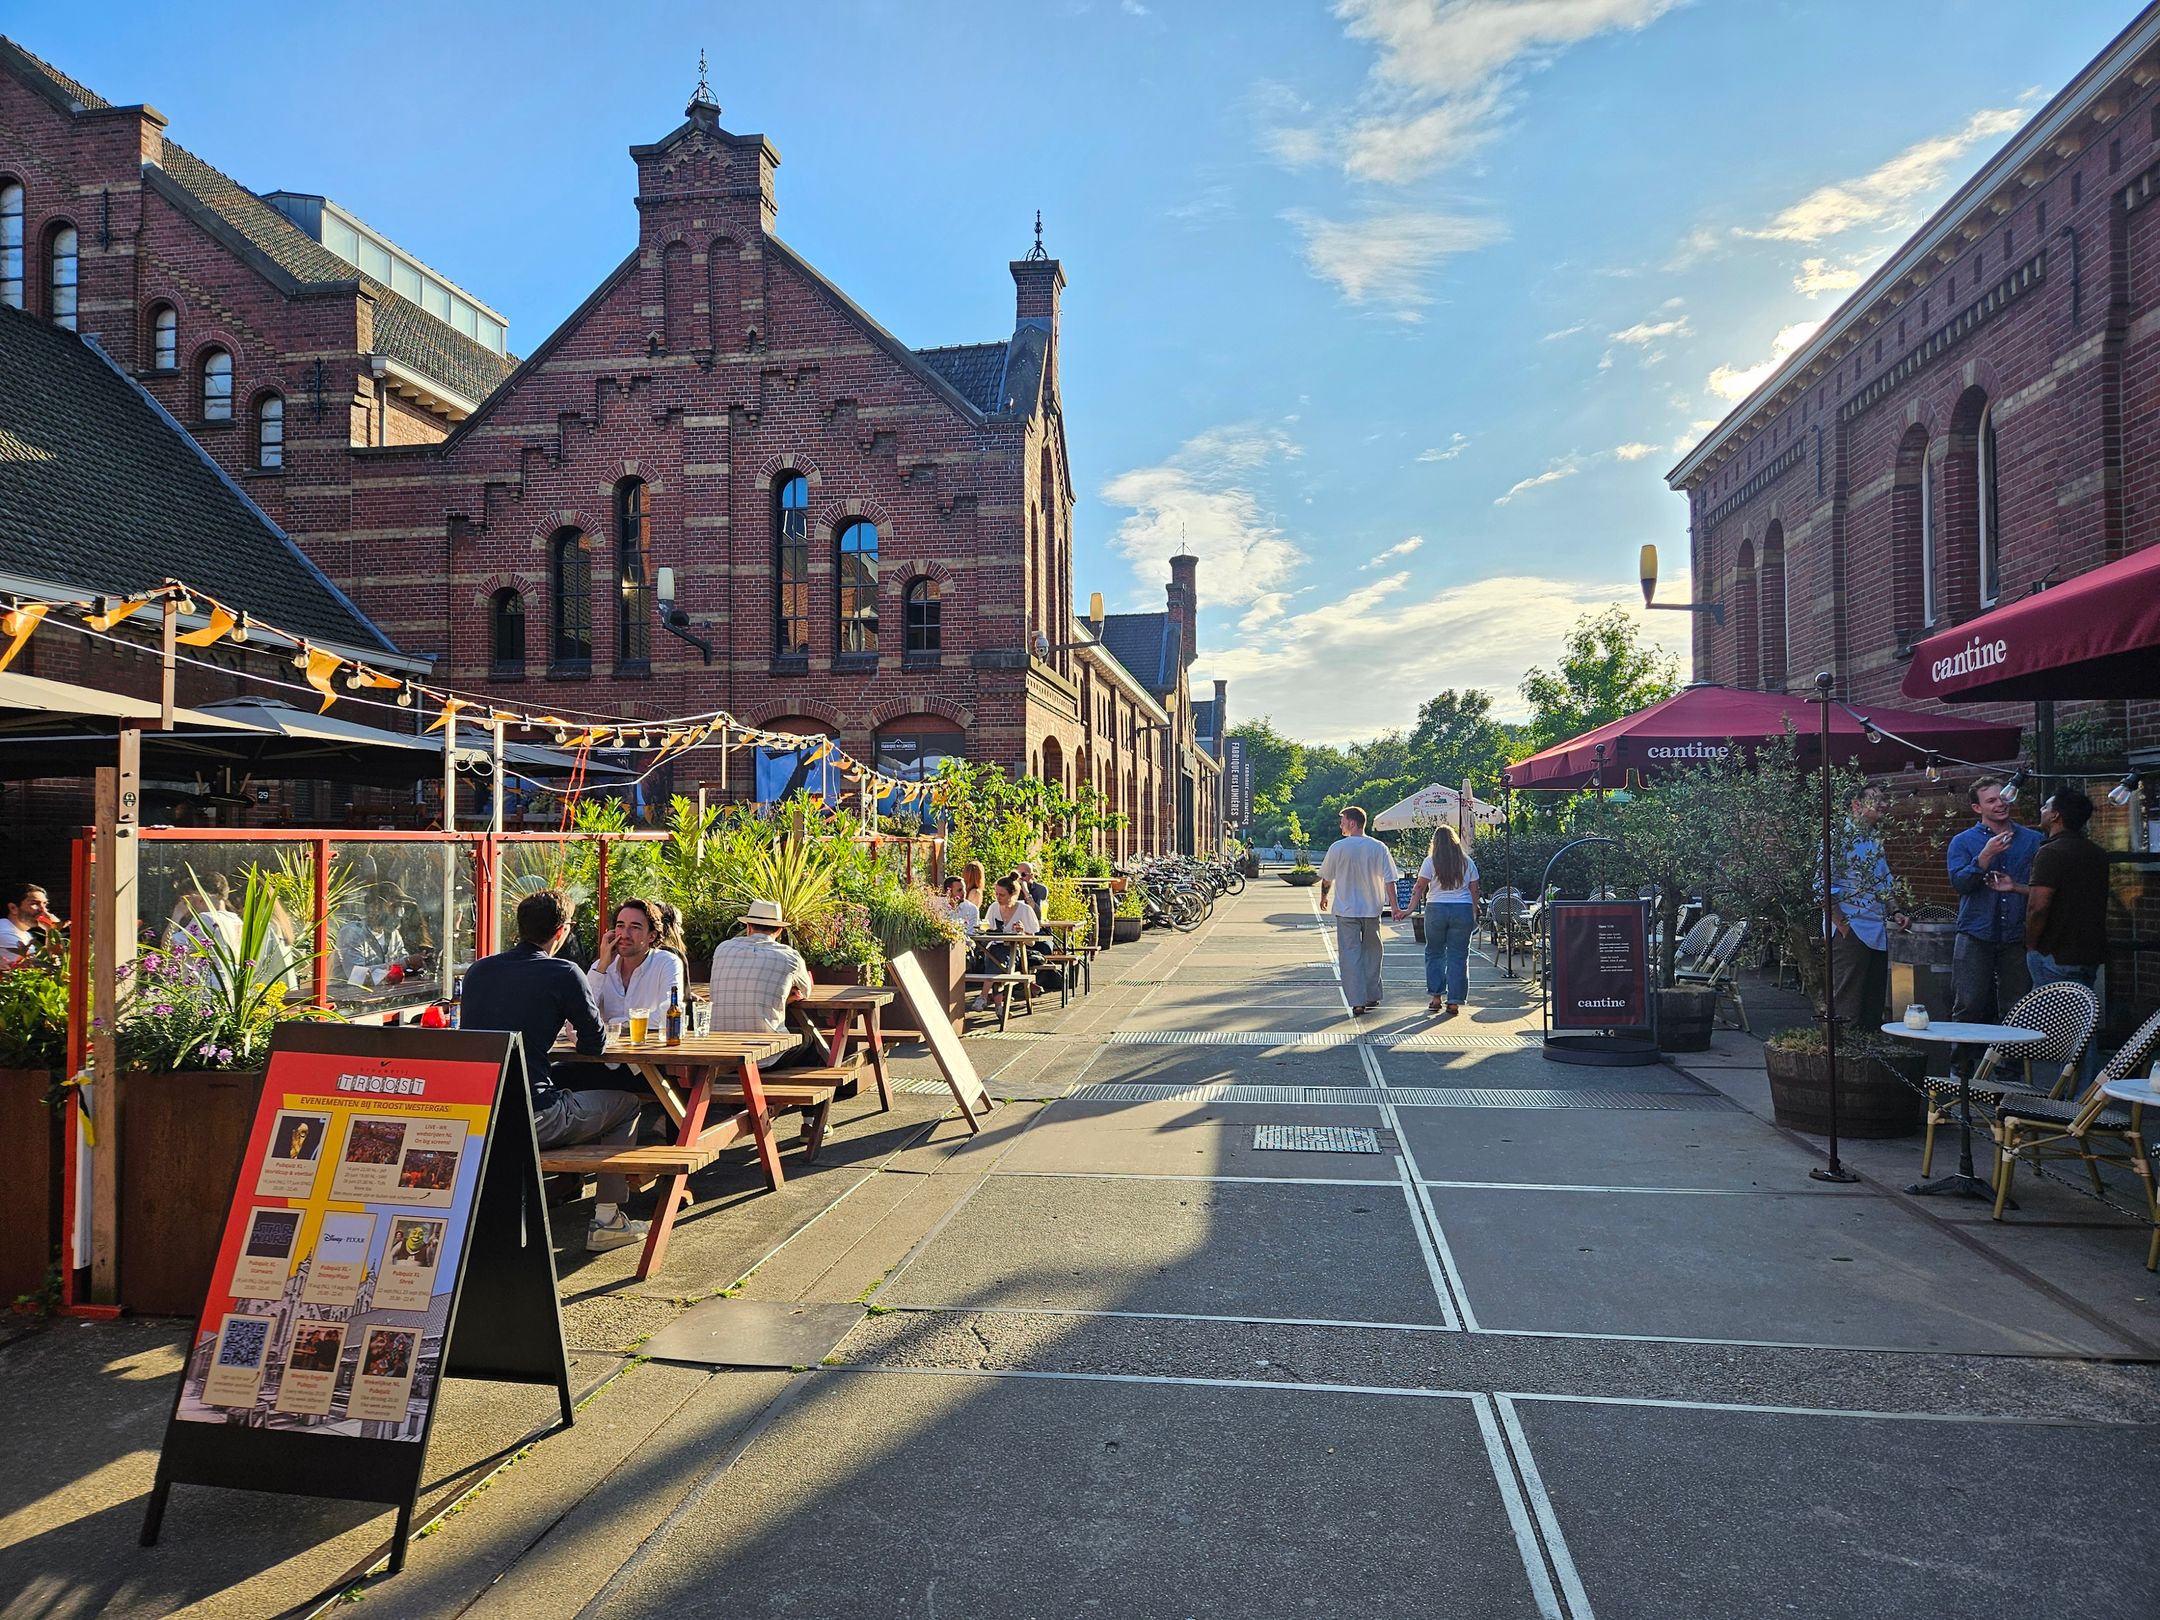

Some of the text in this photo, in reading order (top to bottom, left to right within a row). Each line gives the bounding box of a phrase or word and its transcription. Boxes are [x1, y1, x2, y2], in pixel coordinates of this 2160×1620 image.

[1931, 636, 2007, 683] cantine
[1647, 741, 1729, 758] cantine
[1231, 742, 1240, 816] FABRIQUE DES LUMIÈRES
[258, 791, 269, 799] 29
[1578, 997, 1626, 1008] cantine
[360, 1067, 408, 1075] brouwerij
[341, 1075, 425, 1095] TROOST
[300, 1097, 449, 1112] EVENEMENTEN BIJ TROOST WESTERGAS
[252, 1222, 294, 1234] STAR
[251, 1231, 293, 1246] WARS
[324, 1233, 343, 1244] Disney
